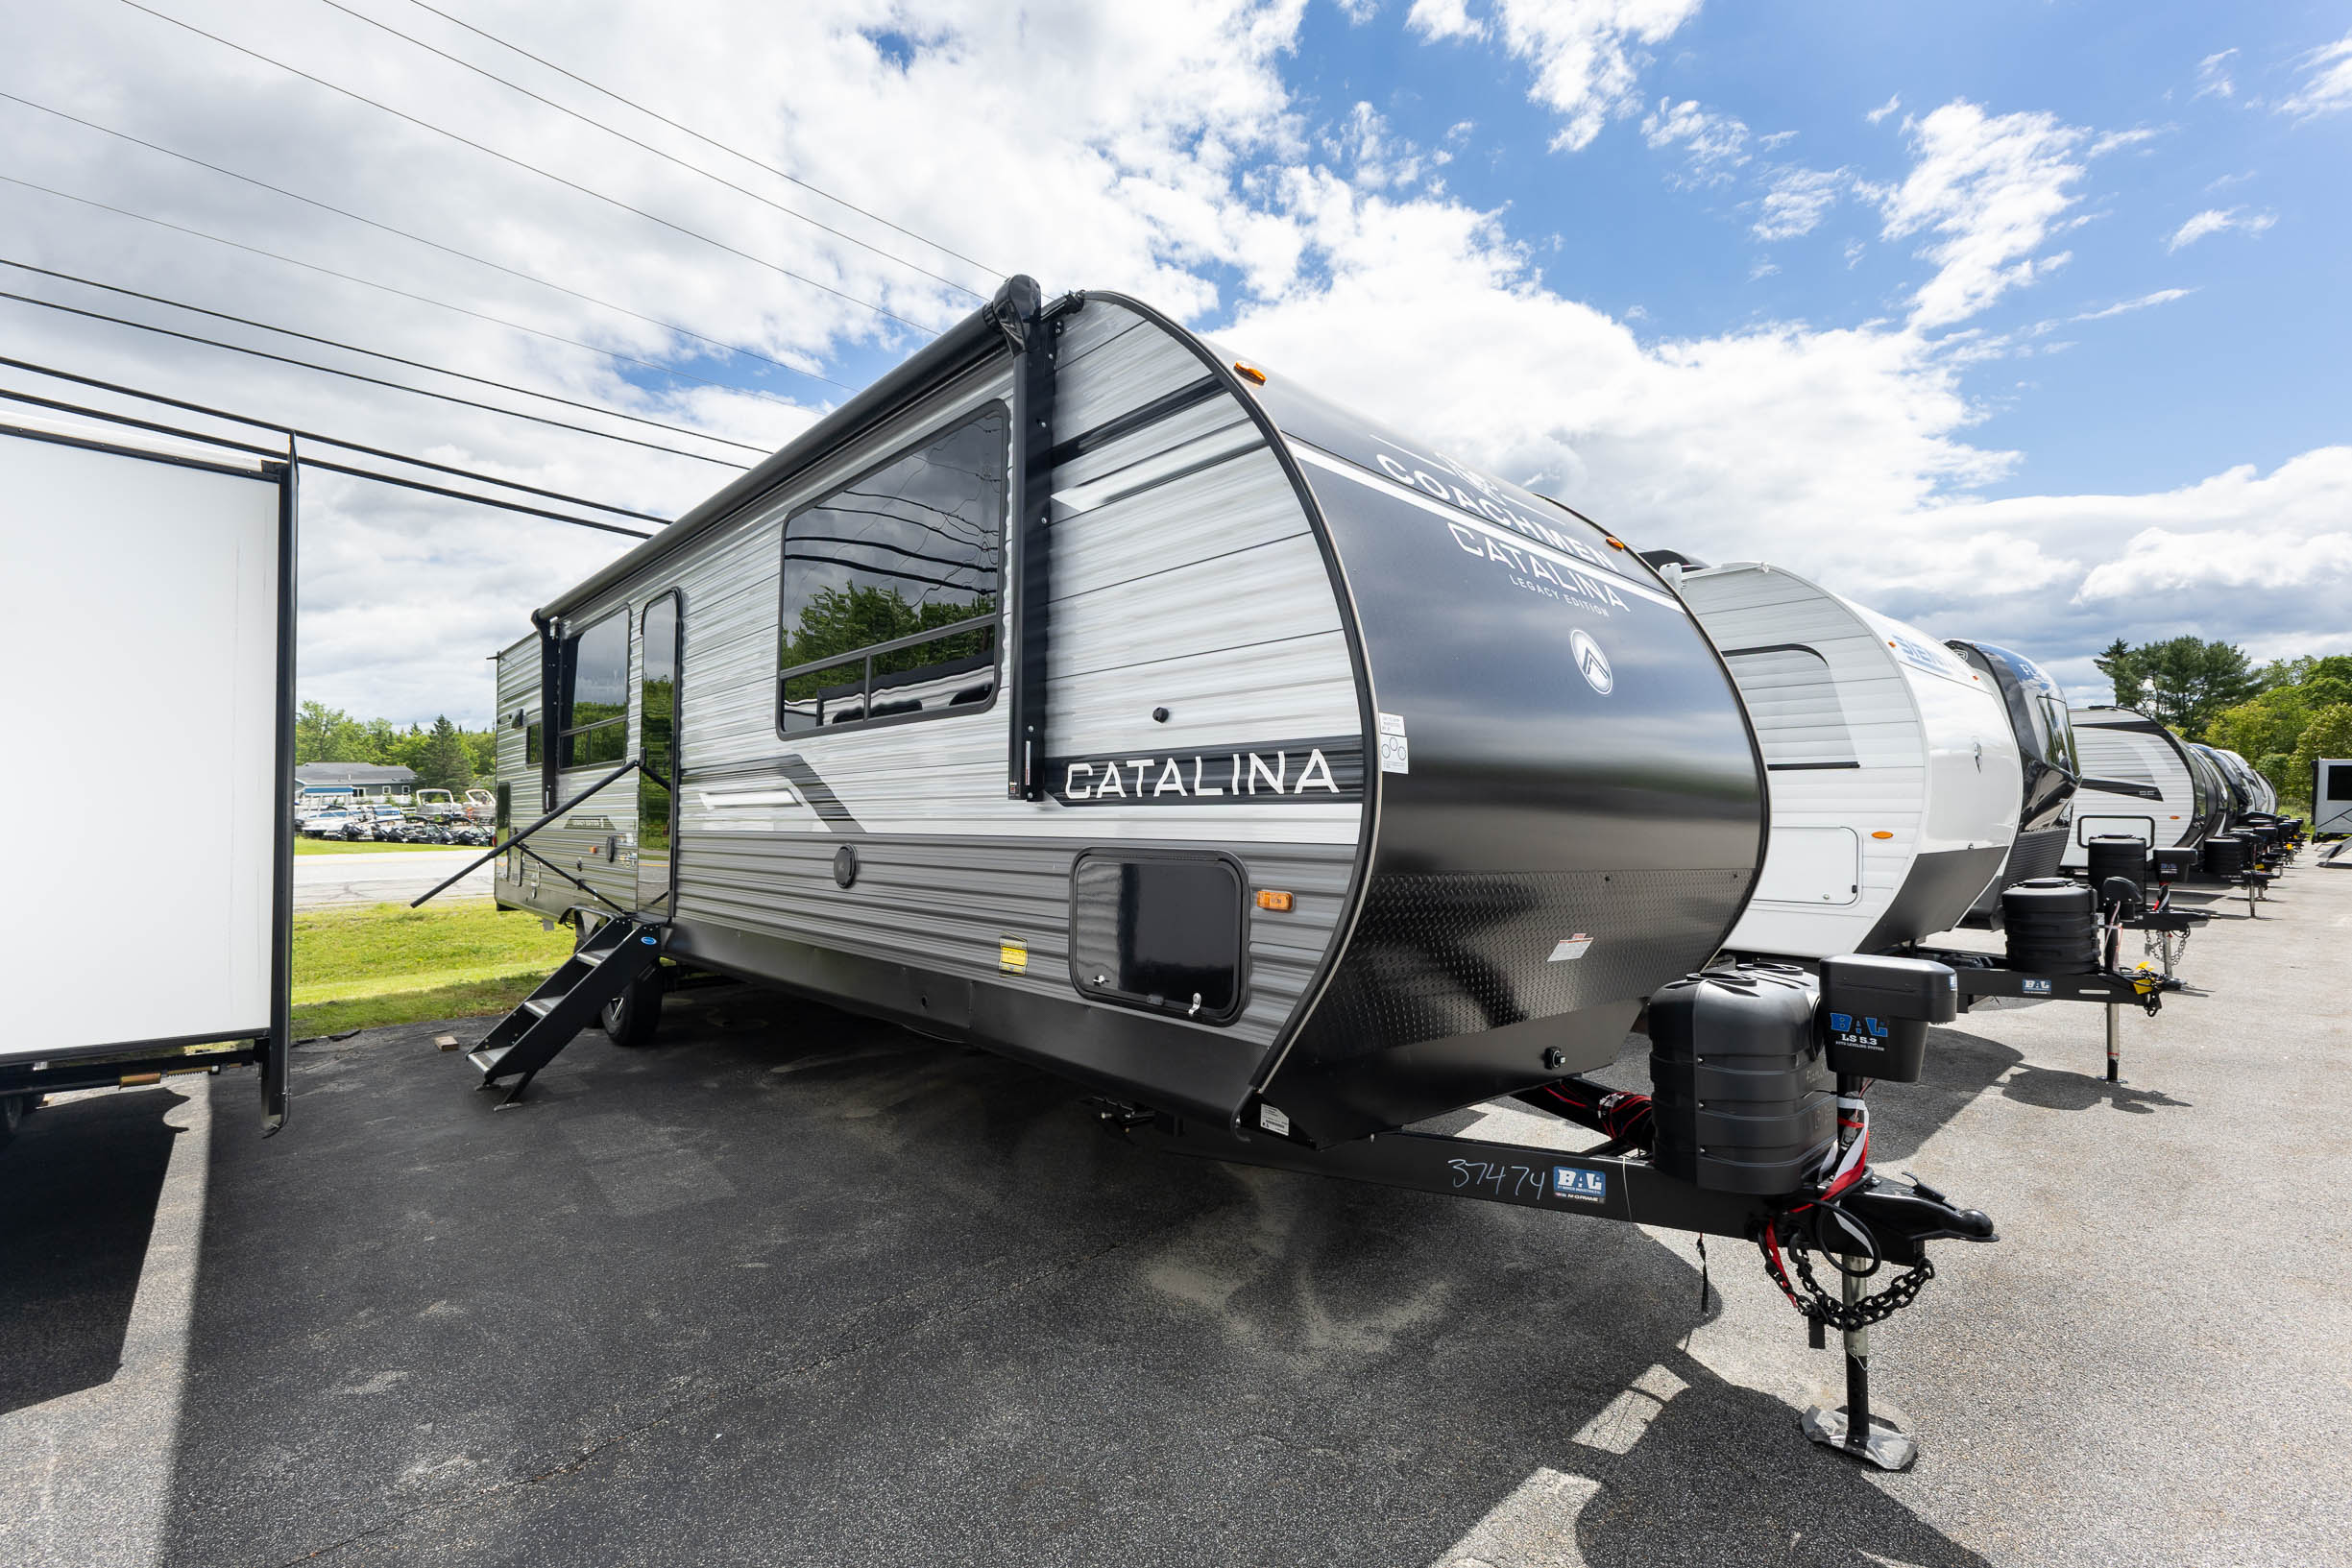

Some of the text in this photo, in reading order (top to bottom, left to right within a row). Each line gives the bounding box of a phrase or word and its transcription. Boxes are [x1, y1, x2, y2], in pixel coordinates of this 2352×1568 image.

[1376, 454, 1620, 572] COACHMEN
[1447, 522, 1631, 612] CATALINA
[1509, 574, 1610, 616] LEGACY EDITION
[1064, 748, 1341, 800] CATALINA
[1830, 1012, 1888, 1037] BAL
[1841, 1033, 1857, 1043] LS
[1447, 1158, 1545, 1200] 37474
[1558, 1168, 1602, 1191] BAL
